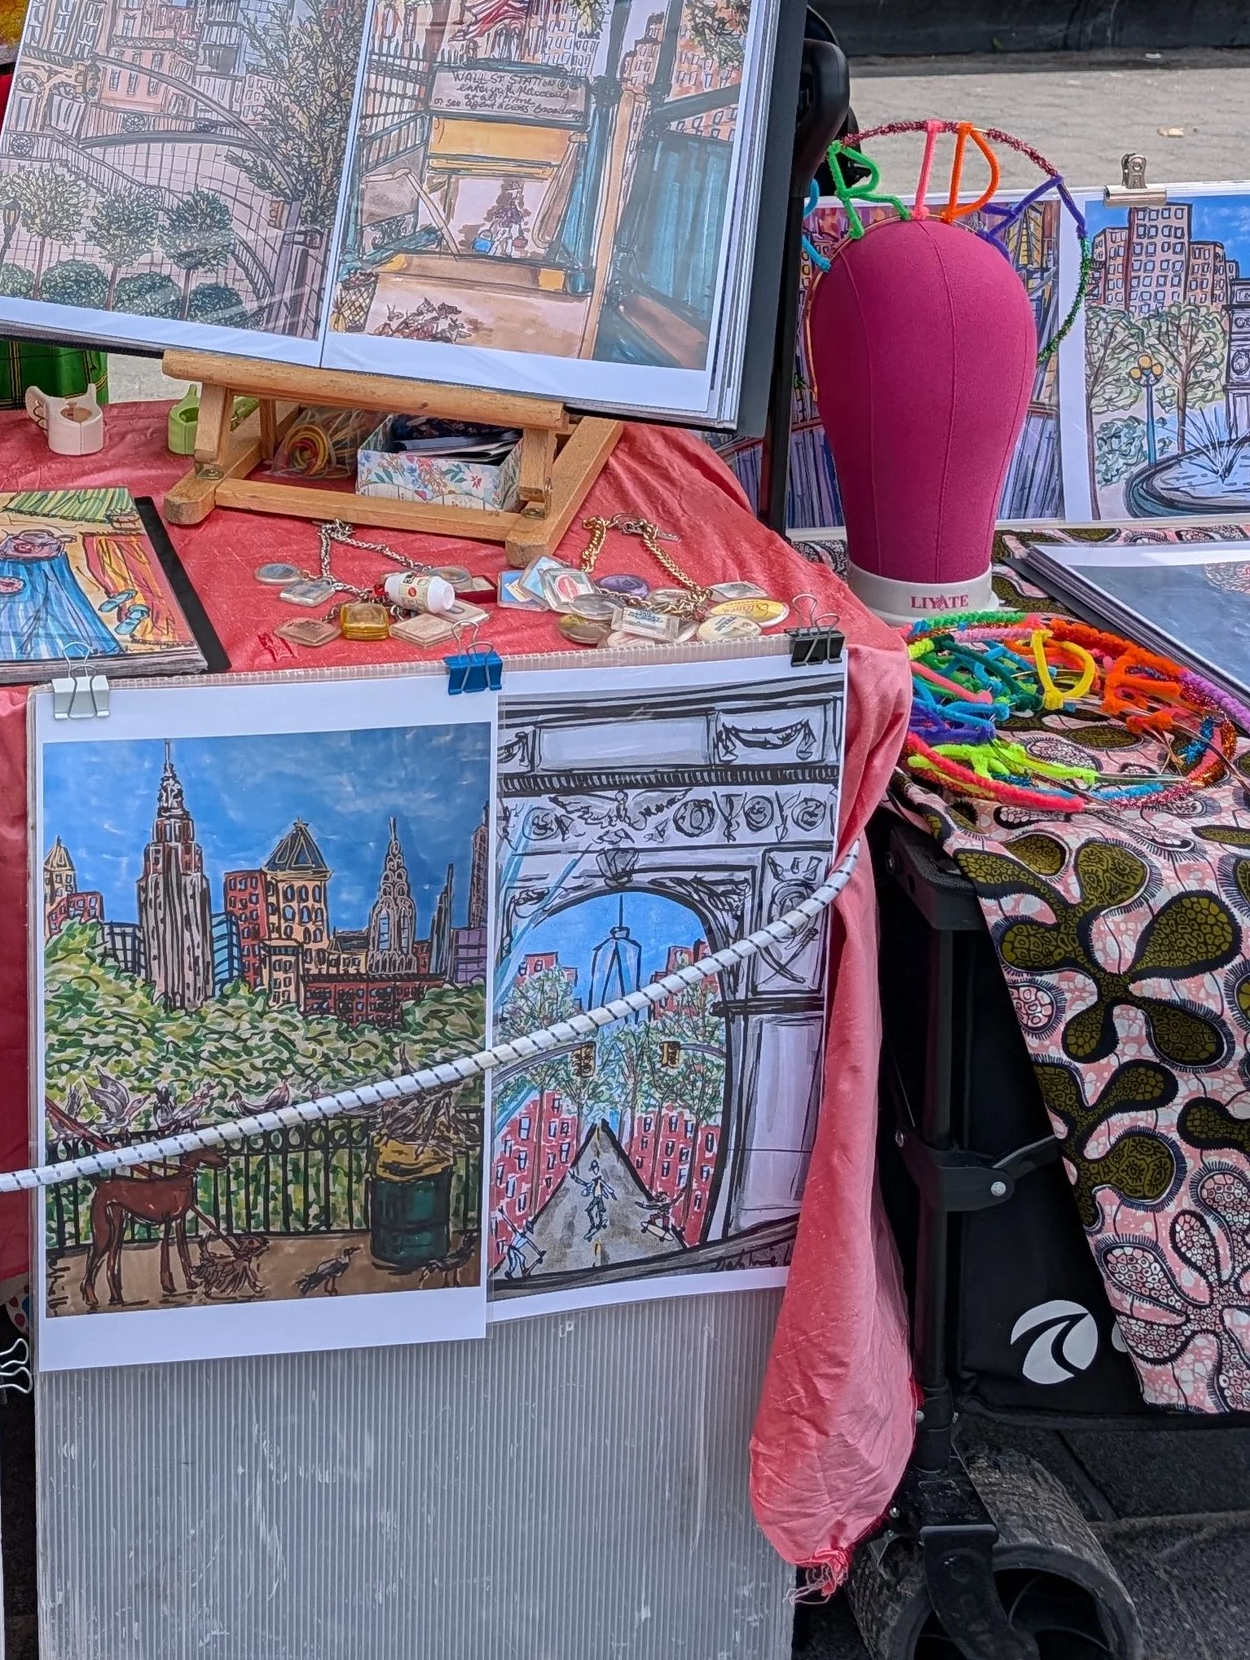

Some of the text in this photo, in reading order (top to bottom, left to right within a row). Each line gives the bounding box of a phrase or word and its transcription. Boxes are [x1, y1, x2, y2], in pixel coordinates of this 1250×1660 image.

[452, 71, 488, 84] WALL
[490, 73, 505, 84] ST
[508, 73, 556, 87] STATION
[910, 594, 969, 611] LIYATE
